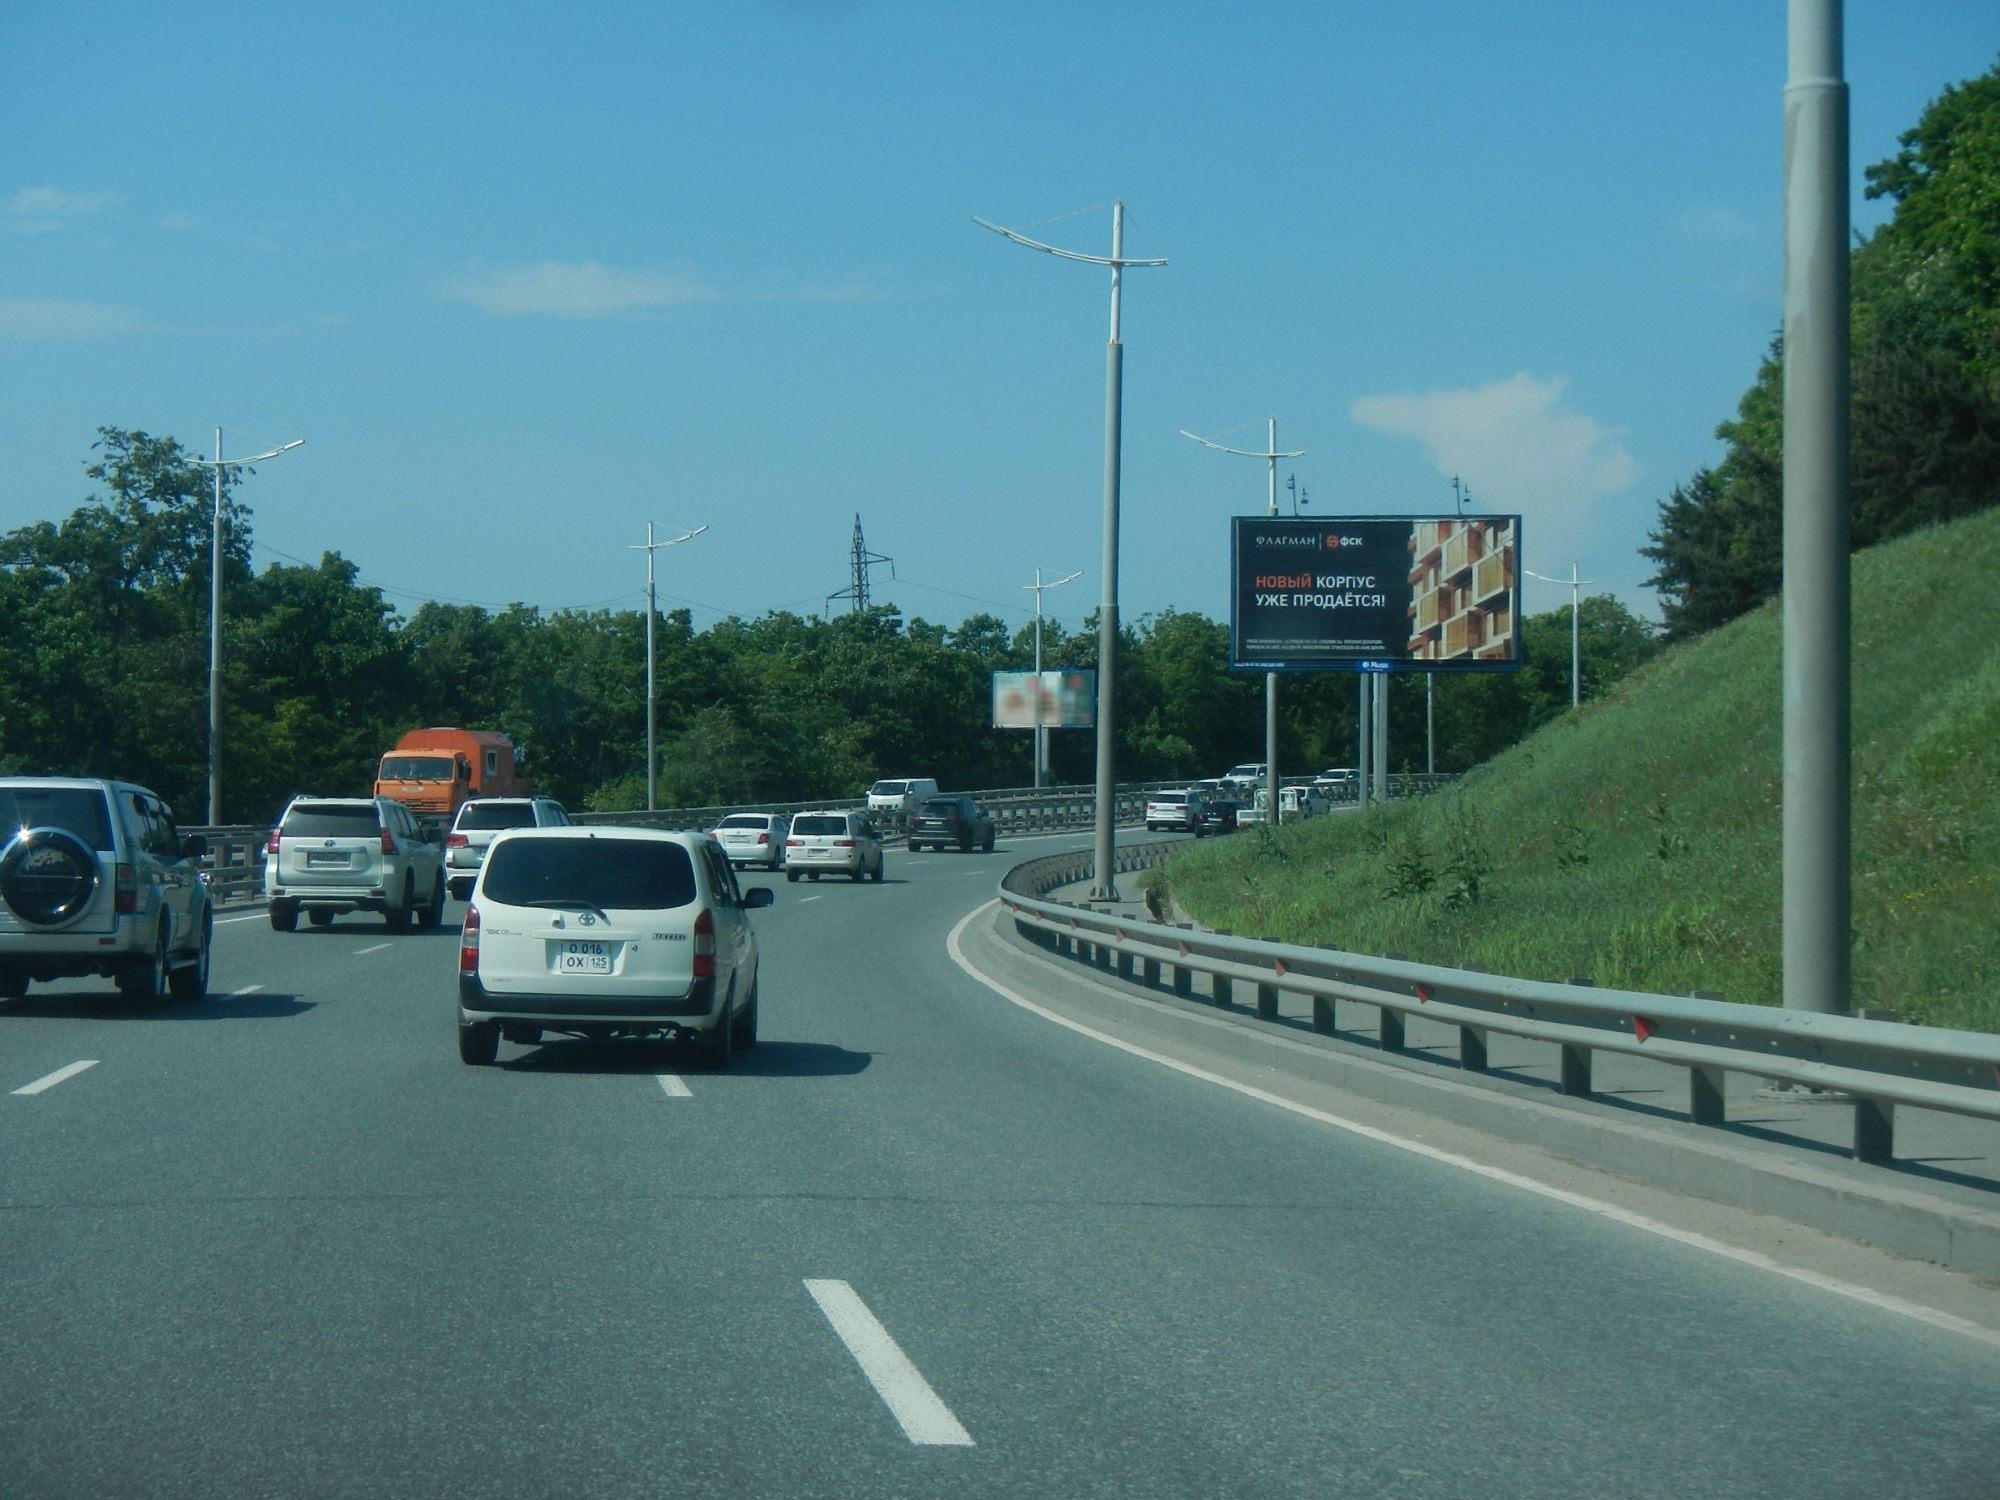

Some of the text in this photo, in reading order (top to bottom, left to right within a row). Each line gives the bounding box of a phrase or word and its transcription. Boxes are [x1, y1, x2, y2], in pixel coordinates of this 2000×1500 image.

[1256, 536, 1363, 547] ФЛАГМАН ФСК
[1255, 573, 1376, 589] НОВЫЙ КОРПУС
[1256, 592, 1386, 609] УЖЕ ПРОДАЁТСЯ!
[581, 944, 602, 954] 016
[590, 957, 607, 966] 125
